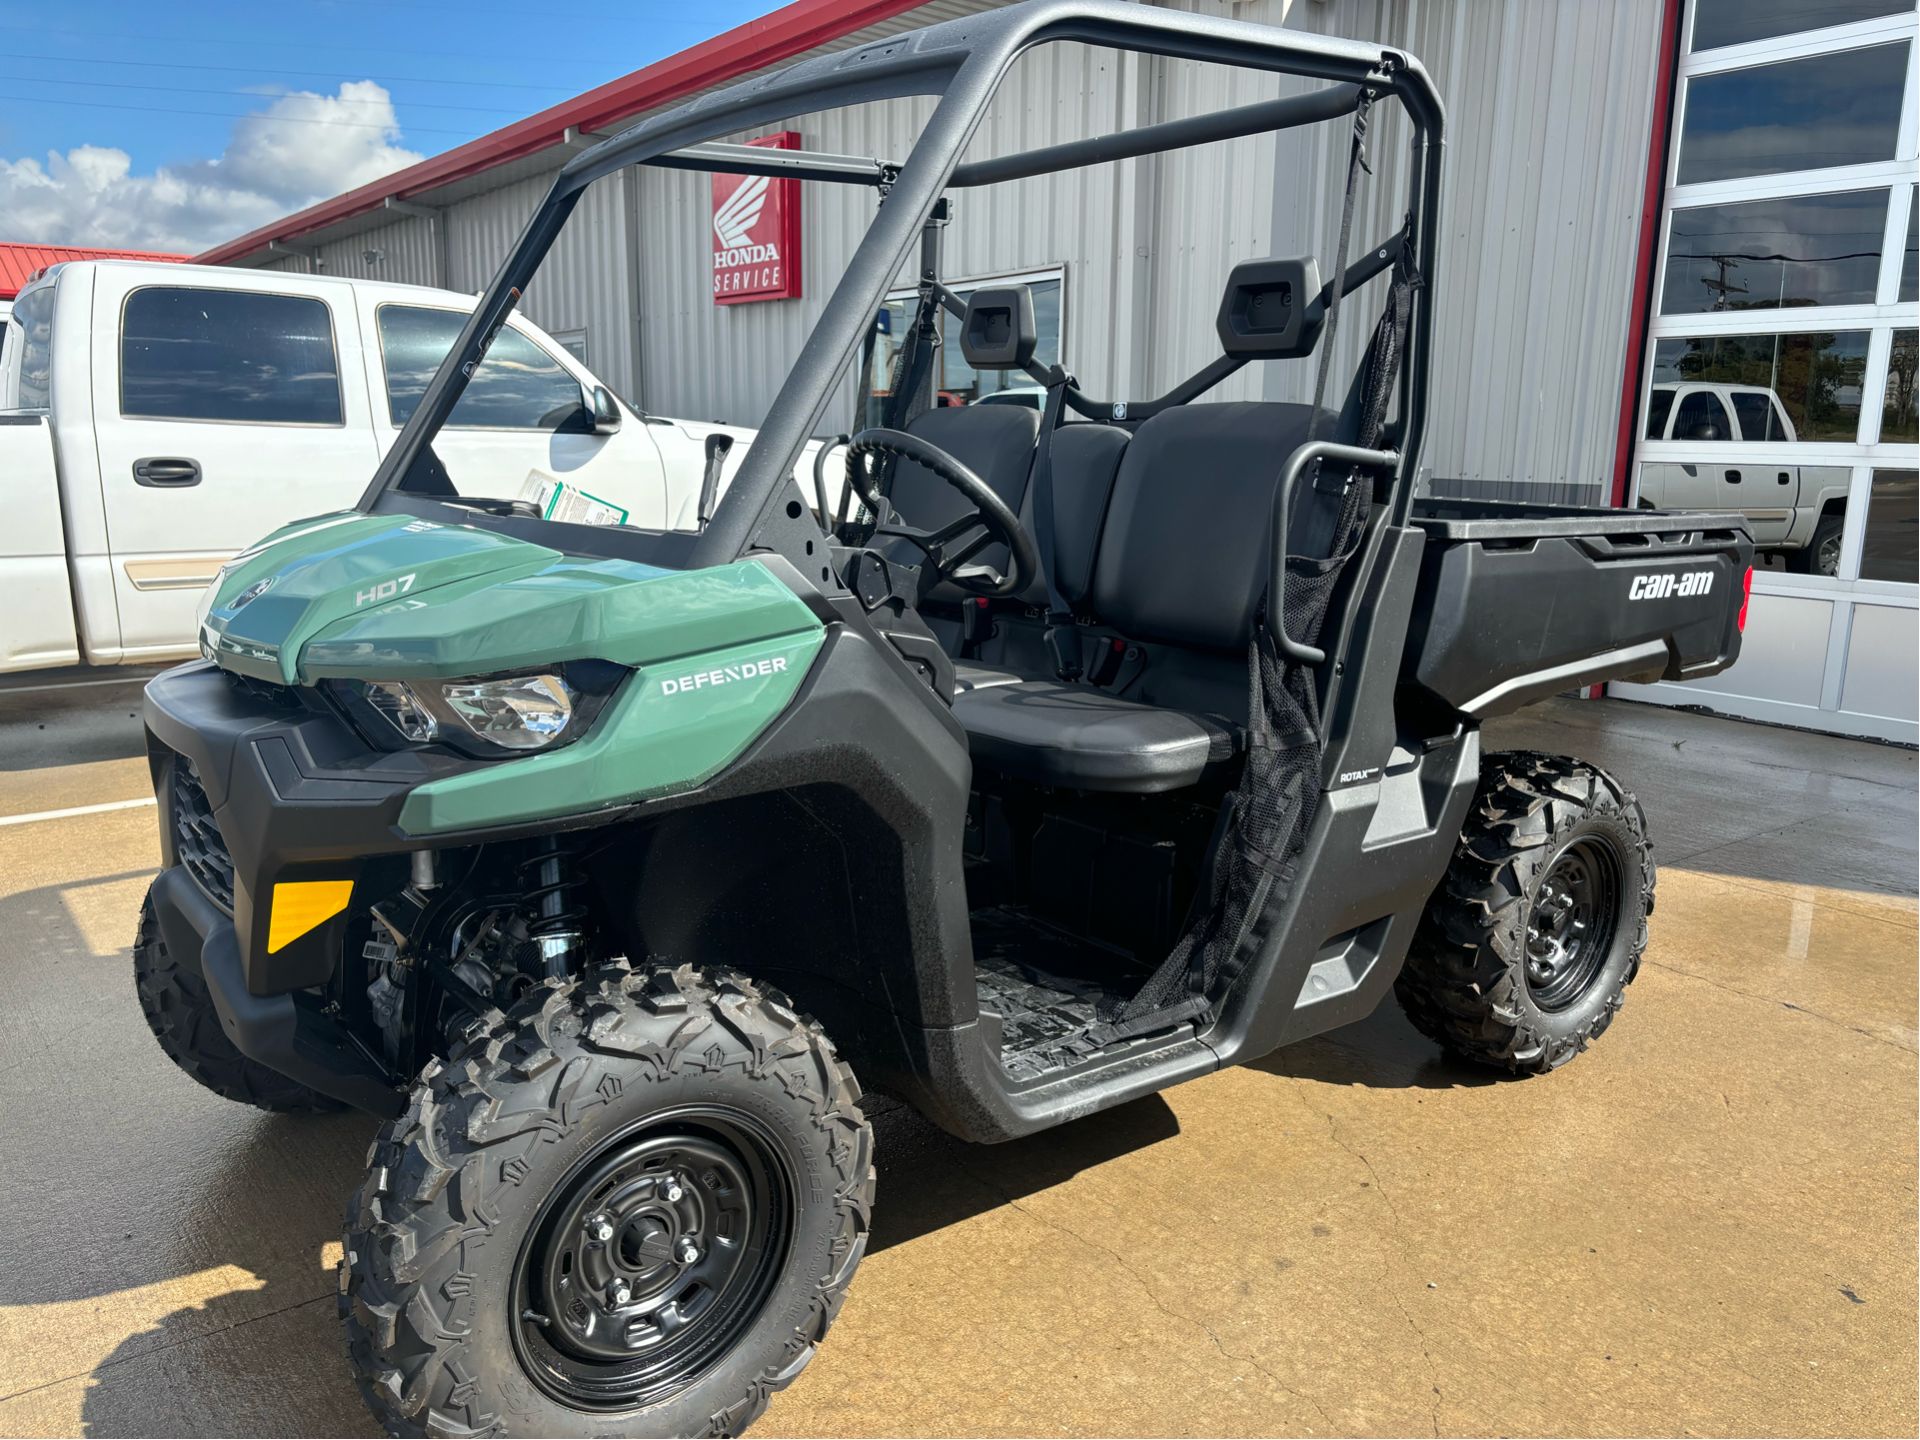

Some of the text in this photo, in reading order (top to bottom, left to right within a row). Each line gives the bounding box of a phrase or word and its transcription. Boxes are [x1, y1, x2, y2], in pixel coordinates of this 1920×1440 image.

[714, 243, 780, 268] HONDA
[714, 267, 780, 292] SERVICE
[356, 573, 416, 607] HD7
[1629, 571, 1714, 600] can-am
[661, 657, 787, 696] DEFENDER
[1340, 768, 1368, 783] ROTAX
[793, 1132, 825, 1204] FORCE
